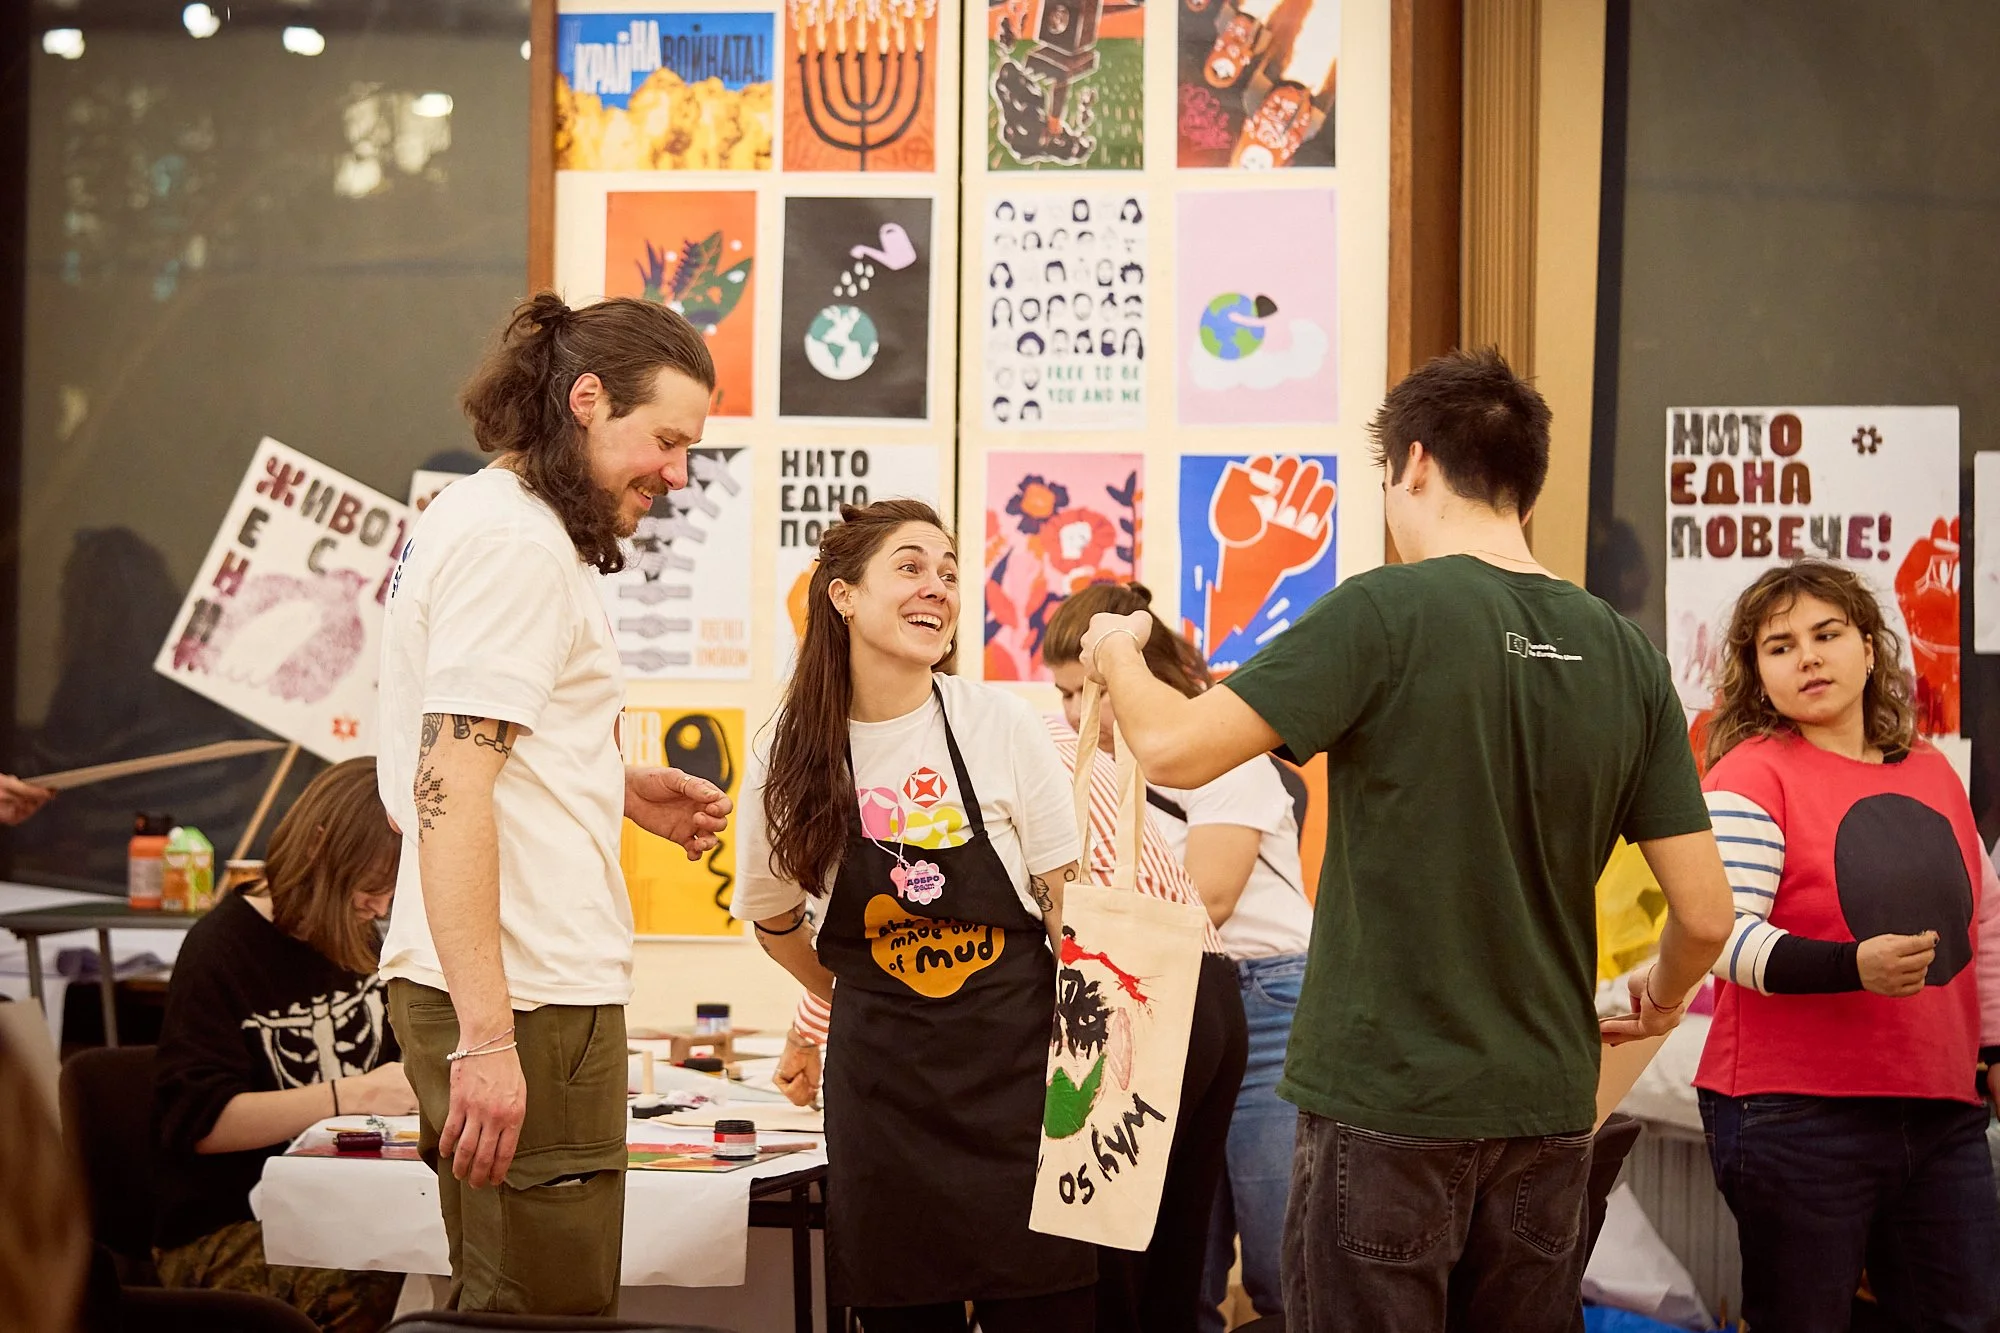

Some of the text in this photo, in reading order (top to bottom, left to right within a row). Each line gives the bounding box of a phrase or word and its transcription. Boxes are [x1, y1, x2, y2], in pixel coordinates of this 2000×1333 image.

[1046, 364, 1139, 381] FREE TO BE
[1047, 387, 1140, 403] YOU AND ME
[1671, 411, 1802, 457] НИТО
[781, 449, 869, 477] НИТО
[1670, 461, 1812, 505] ЕДНА
[781, 484, 868, 512] ЕДНА
[1671, 513, 1893, 561] ПОВЕЧЕ!
